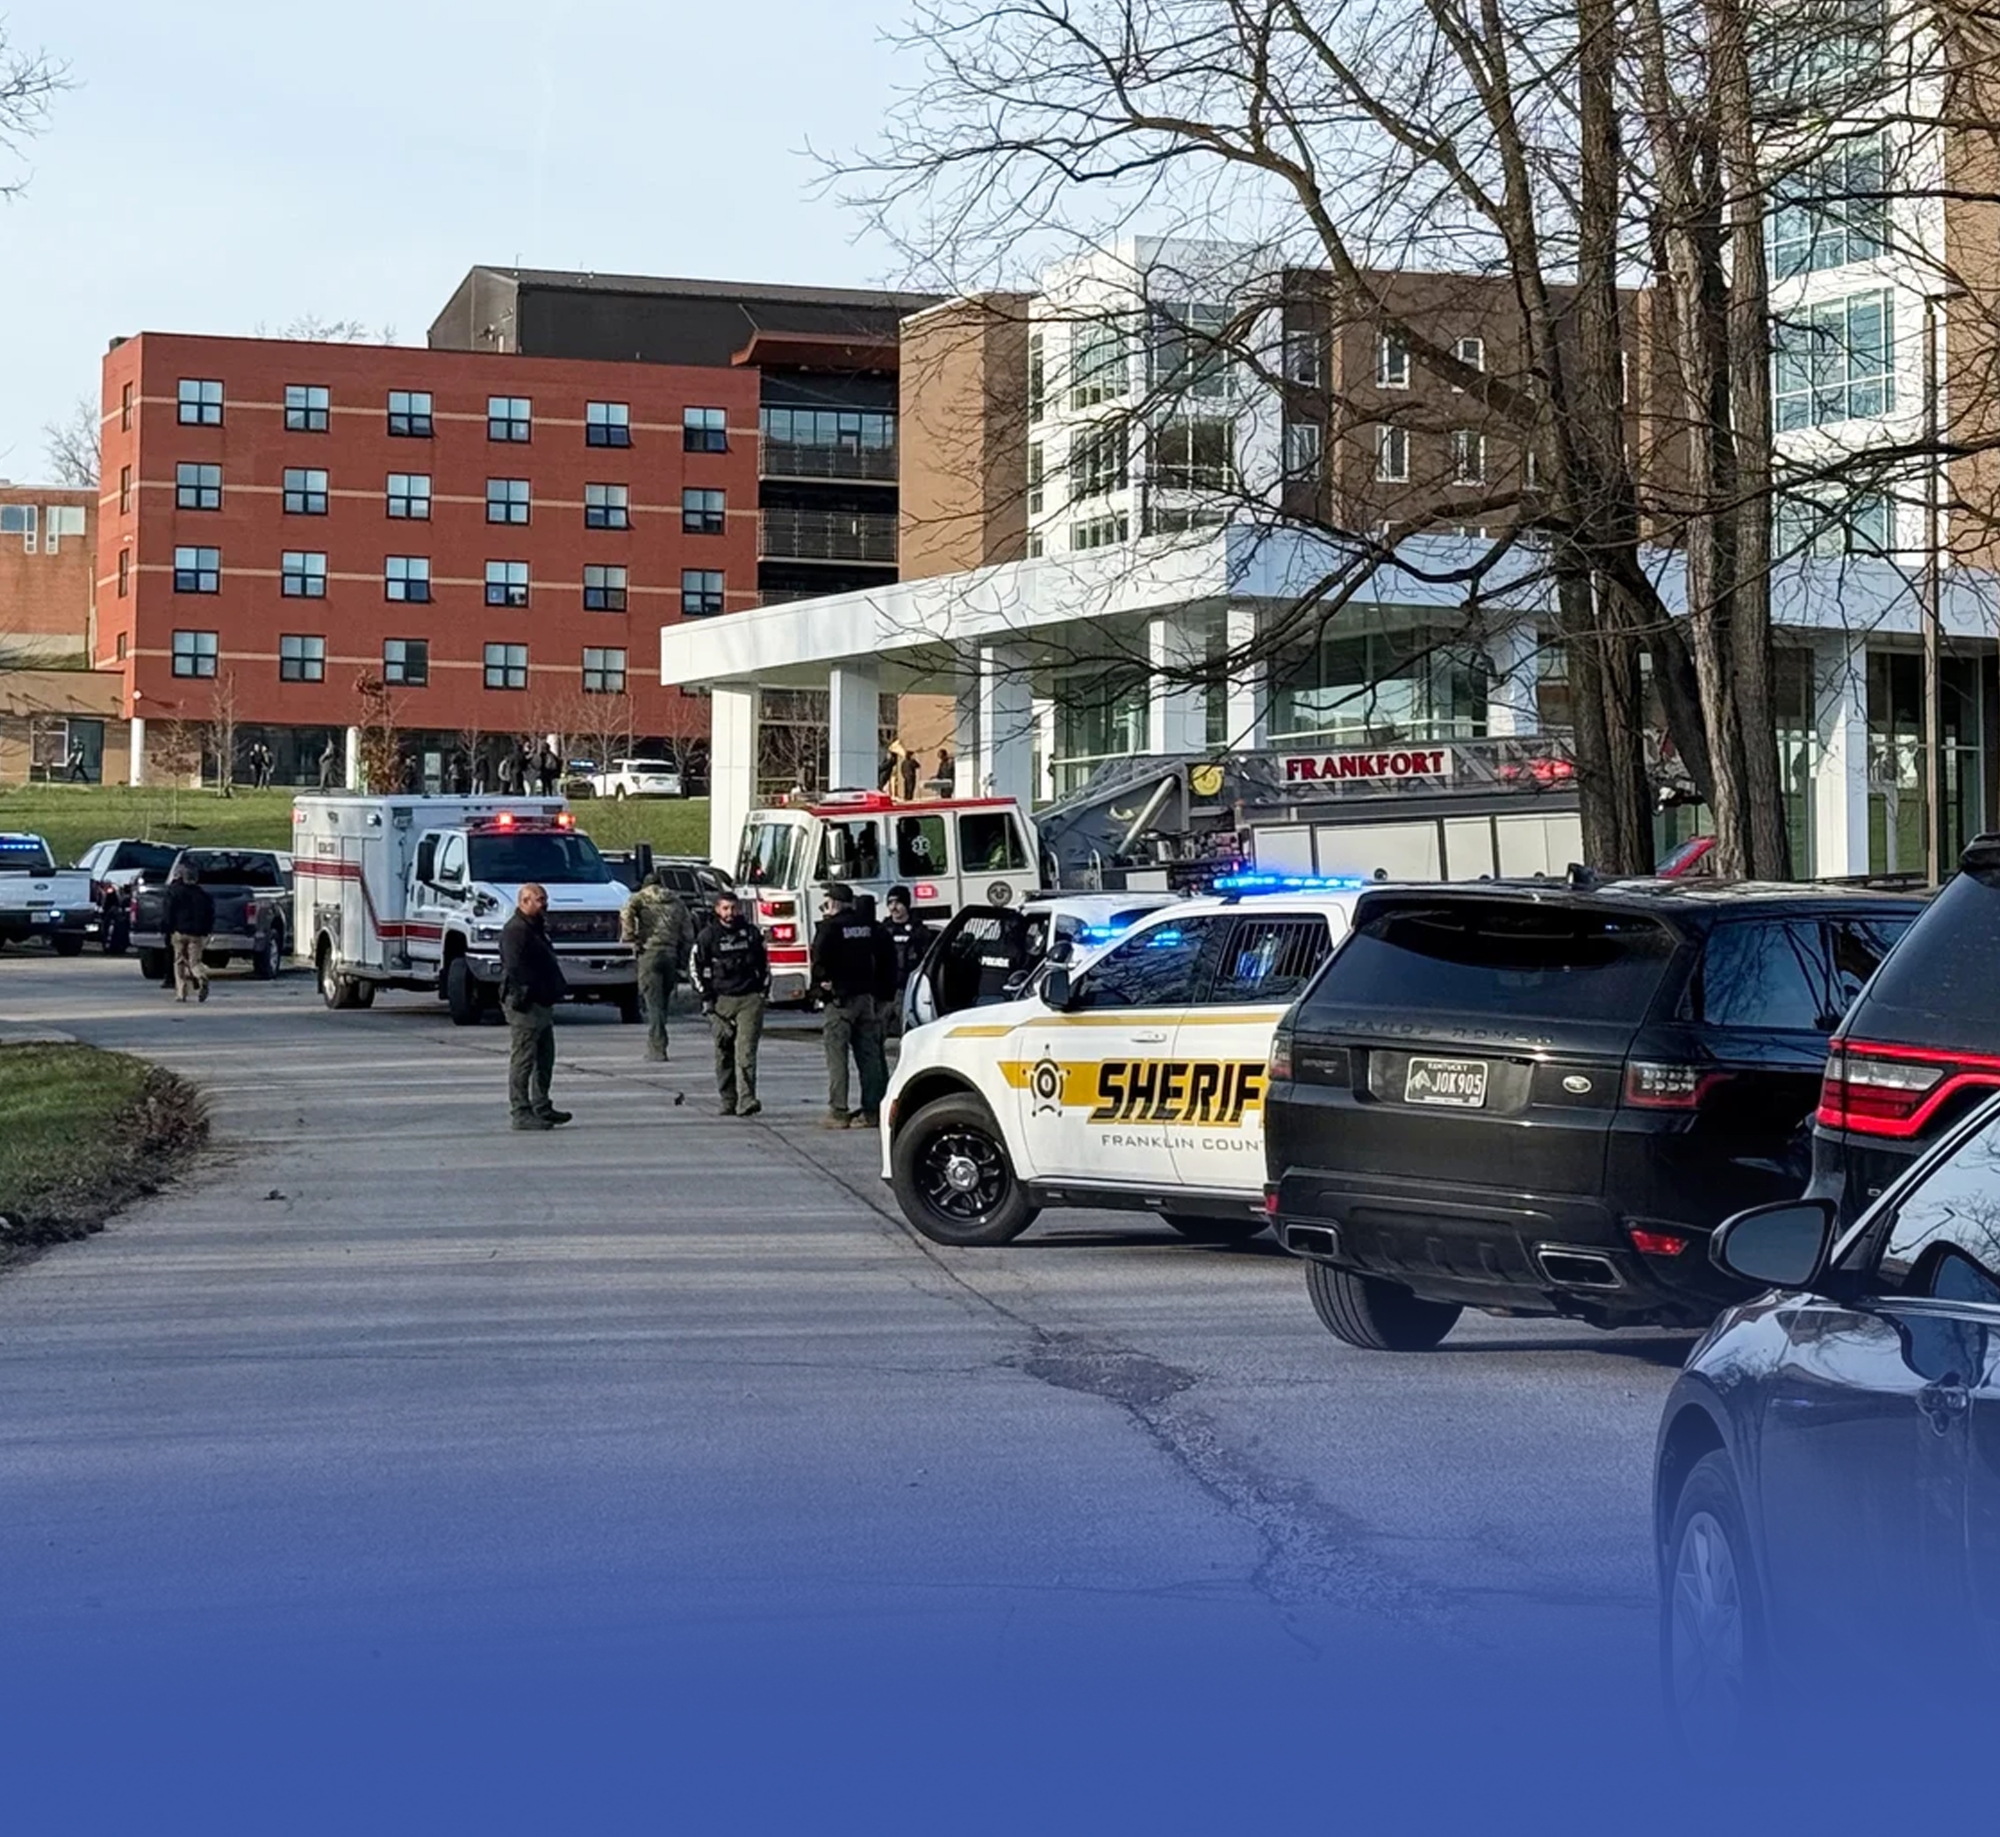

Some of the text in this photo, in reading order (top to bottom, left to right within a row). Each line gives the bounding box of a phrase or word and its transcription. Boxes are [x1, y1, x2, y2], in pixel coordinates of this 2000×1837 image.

[1286, 751, 1445, 781] FRANKFORT
[1089, 1061, 1265, 1124] SHERIF
[1102, 1134, 1195, 1149] FRANKLIN
